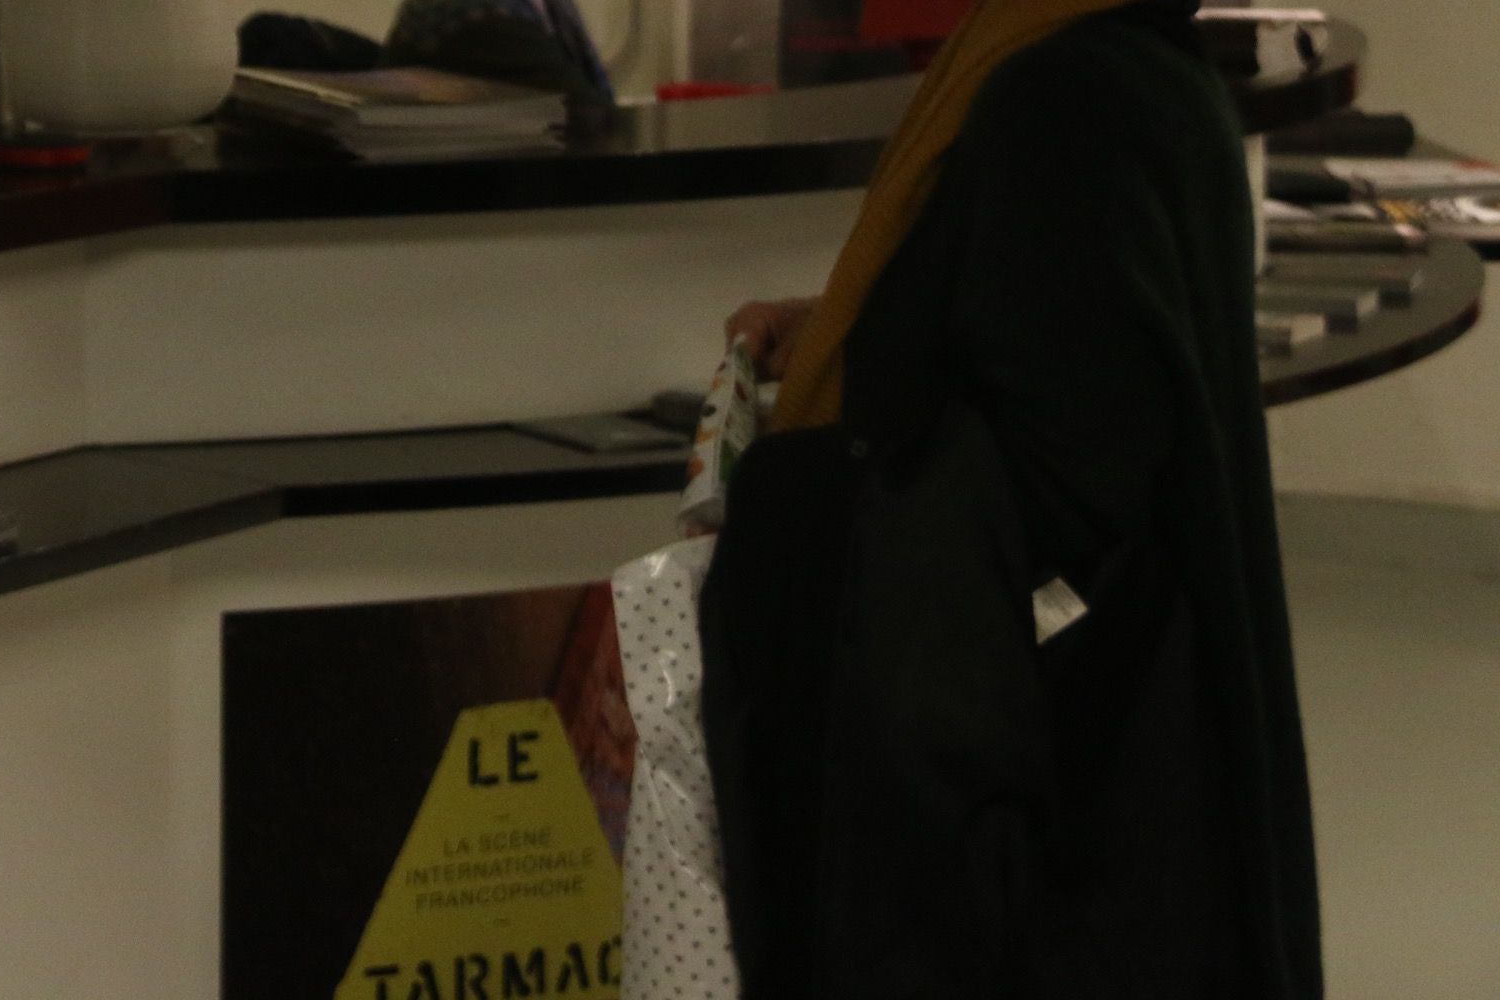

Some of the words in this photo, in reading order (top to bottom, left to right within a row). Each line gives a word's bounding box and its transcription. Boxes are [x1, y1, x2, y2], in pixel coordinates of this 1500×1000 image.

[468, 731, 539, 786] LE
[444, 838, 470, 857] LA
[405, 848, 594, 886] INTERNATIONALE
[415, 876, 584, 912] FRANCOPHONE
